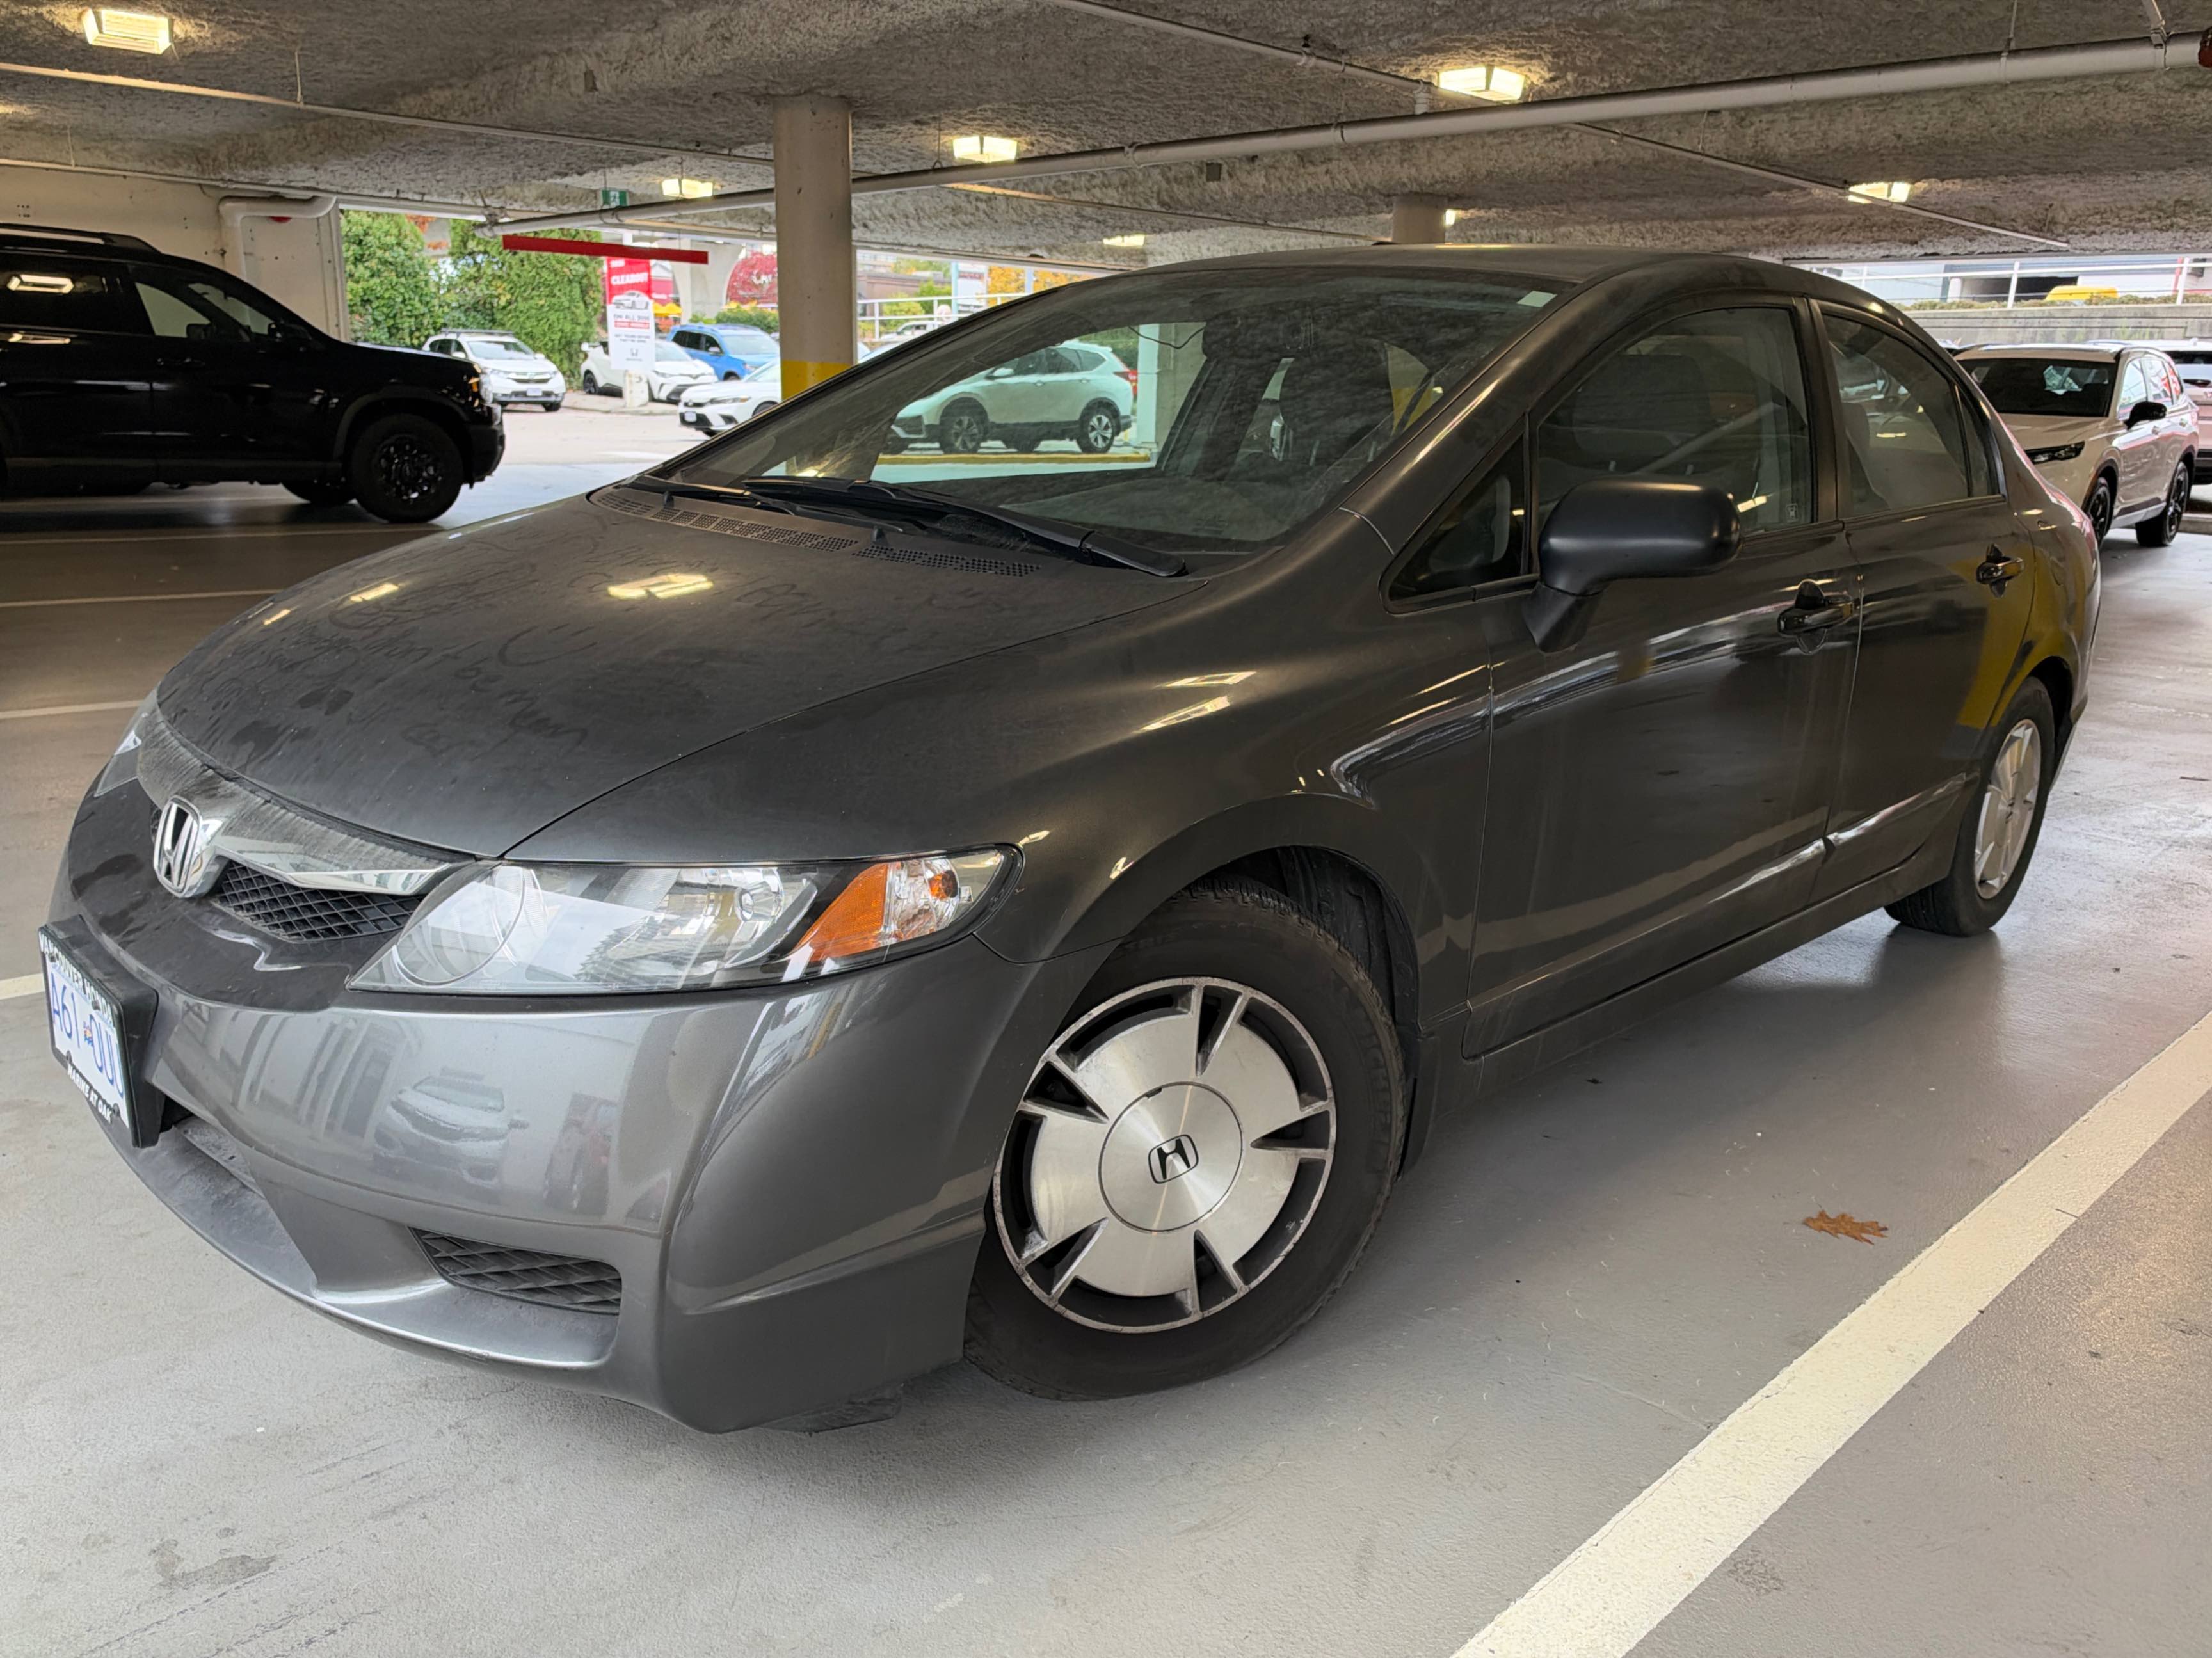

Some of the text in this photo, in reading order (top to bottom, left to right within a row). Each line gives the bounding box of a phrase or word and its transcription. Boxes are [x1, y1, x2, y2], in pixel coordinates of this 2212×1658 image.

[51, 972, 80, 1048] A61
[83, 978, 116, 1027] HONDA
[67, 1064, 112, 1124] MARINE AT OAK
